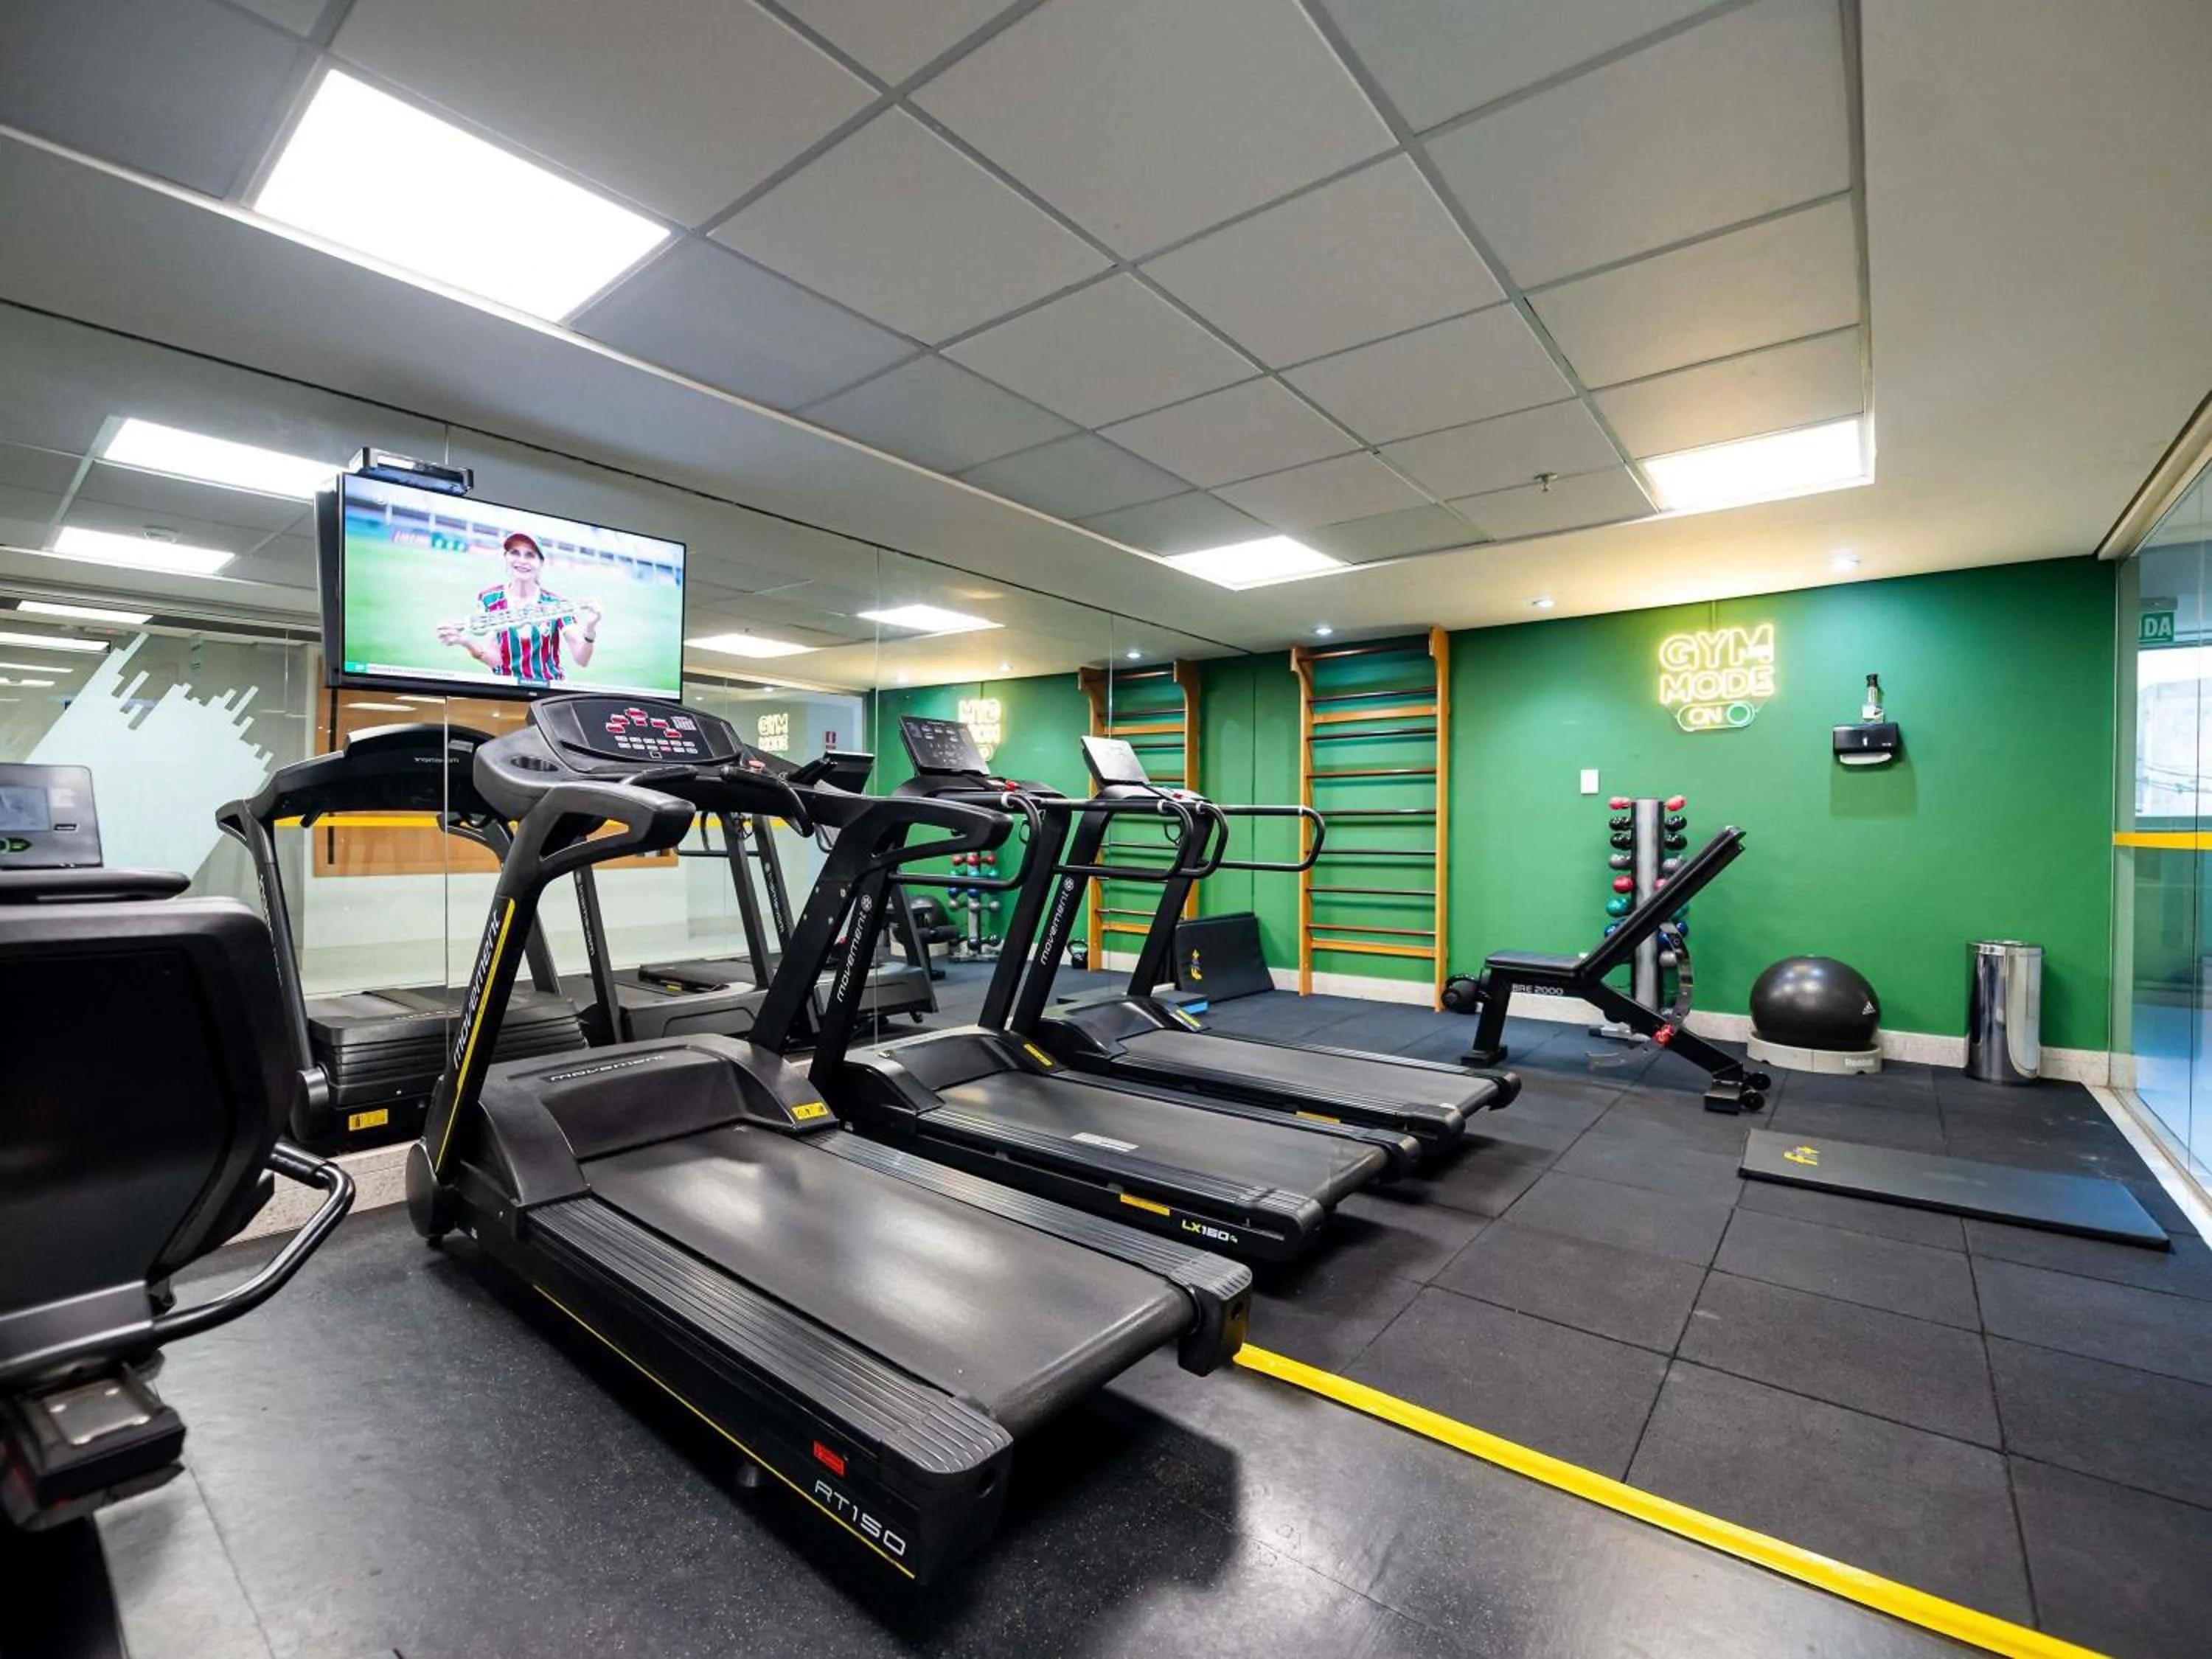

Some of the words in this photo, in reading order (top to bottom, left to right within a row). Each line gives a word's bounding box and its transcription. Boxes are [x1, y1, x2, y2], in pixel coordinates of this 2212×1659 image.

[1659, 624, 1774, 670] GYM
[1659, 665, 1774, 704] MODE
[1689, 706, 1722, 725] ON
[837, 911, 867, 1003] movement
[1040, 890, 1069, 965] movement
[453, 909, 501, 1069] movement
[1534, 985, 1564, 996] 2000
[815, 1479, 906, 1556] RT150
